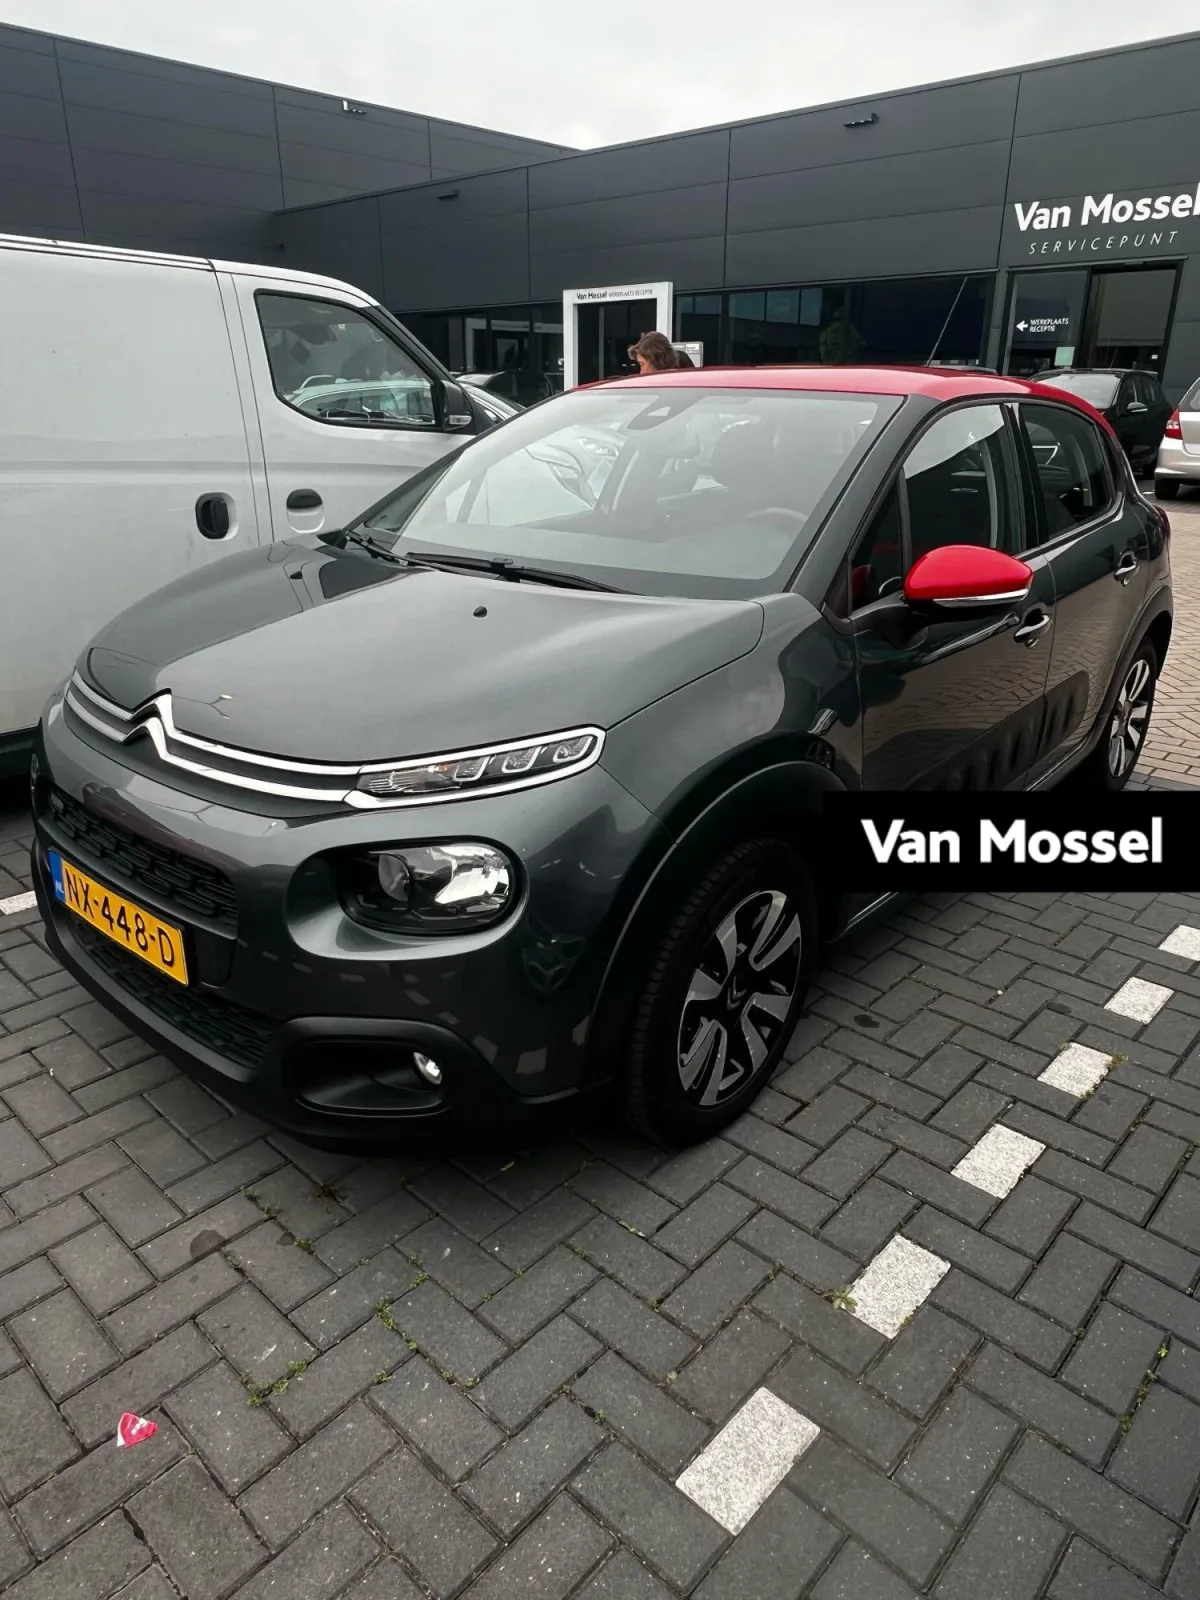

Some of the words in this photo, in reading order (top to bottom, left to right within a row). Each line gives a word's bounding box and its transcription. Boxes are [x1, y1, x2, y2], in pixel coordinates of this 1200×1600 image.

[1014, 201, 1071, 231] Van
[1081, 182, 1200, 226] Mossel
[1029, 230, 1178, 255] SERVICEPUNT
[576, 292, 587, 300] Van
[588, 291, 607, 300] Mossel
[1029, 325, 1056, 333] RECEPTIE
[1030, 317, 1069, 326] WERKPLAATS
[65, 868, 175, 968] NX-448-D
